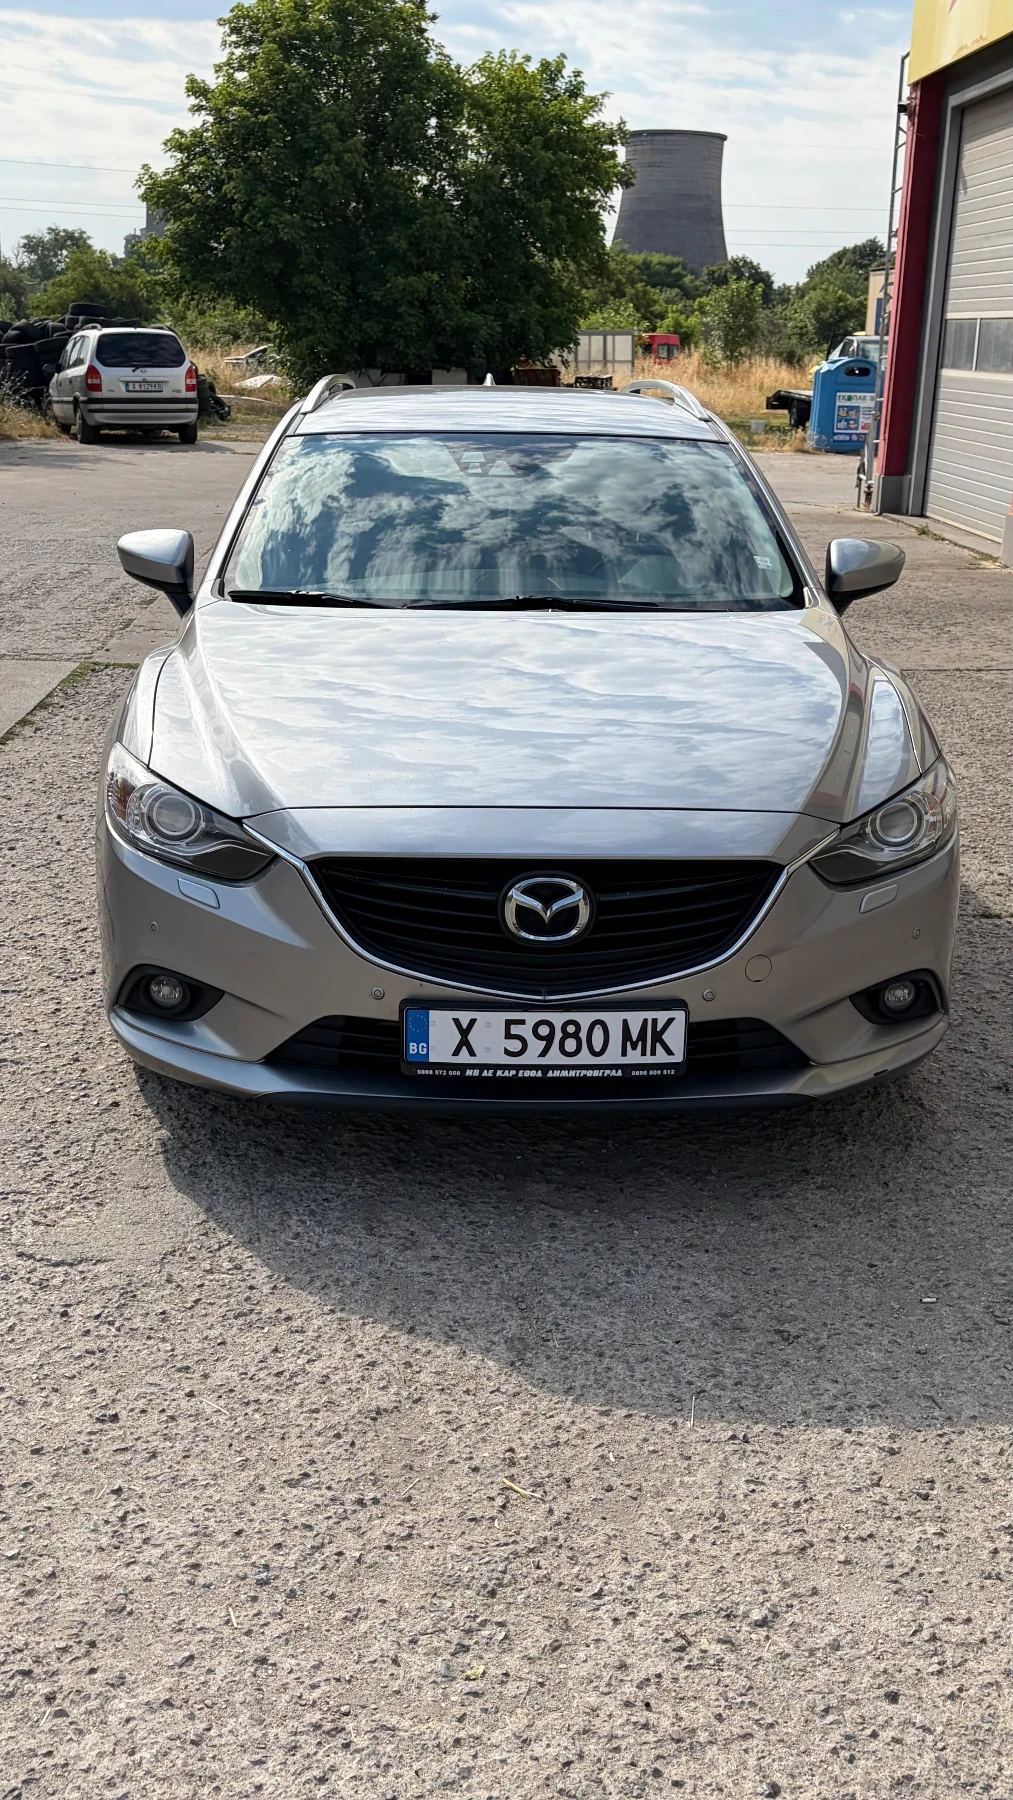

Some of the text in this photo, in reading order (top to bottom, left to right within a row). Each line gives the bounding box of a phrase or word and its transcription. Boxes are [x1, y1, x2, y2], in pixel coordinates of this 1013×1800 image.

[451, 1017, 676, 1058] X 5980 MK
[409, 1042, 427, 1055] BG
[496, 1069, 516, 1077] КАР
[547, 1069, 622, 1077] ДИМИТРОВГРАД
